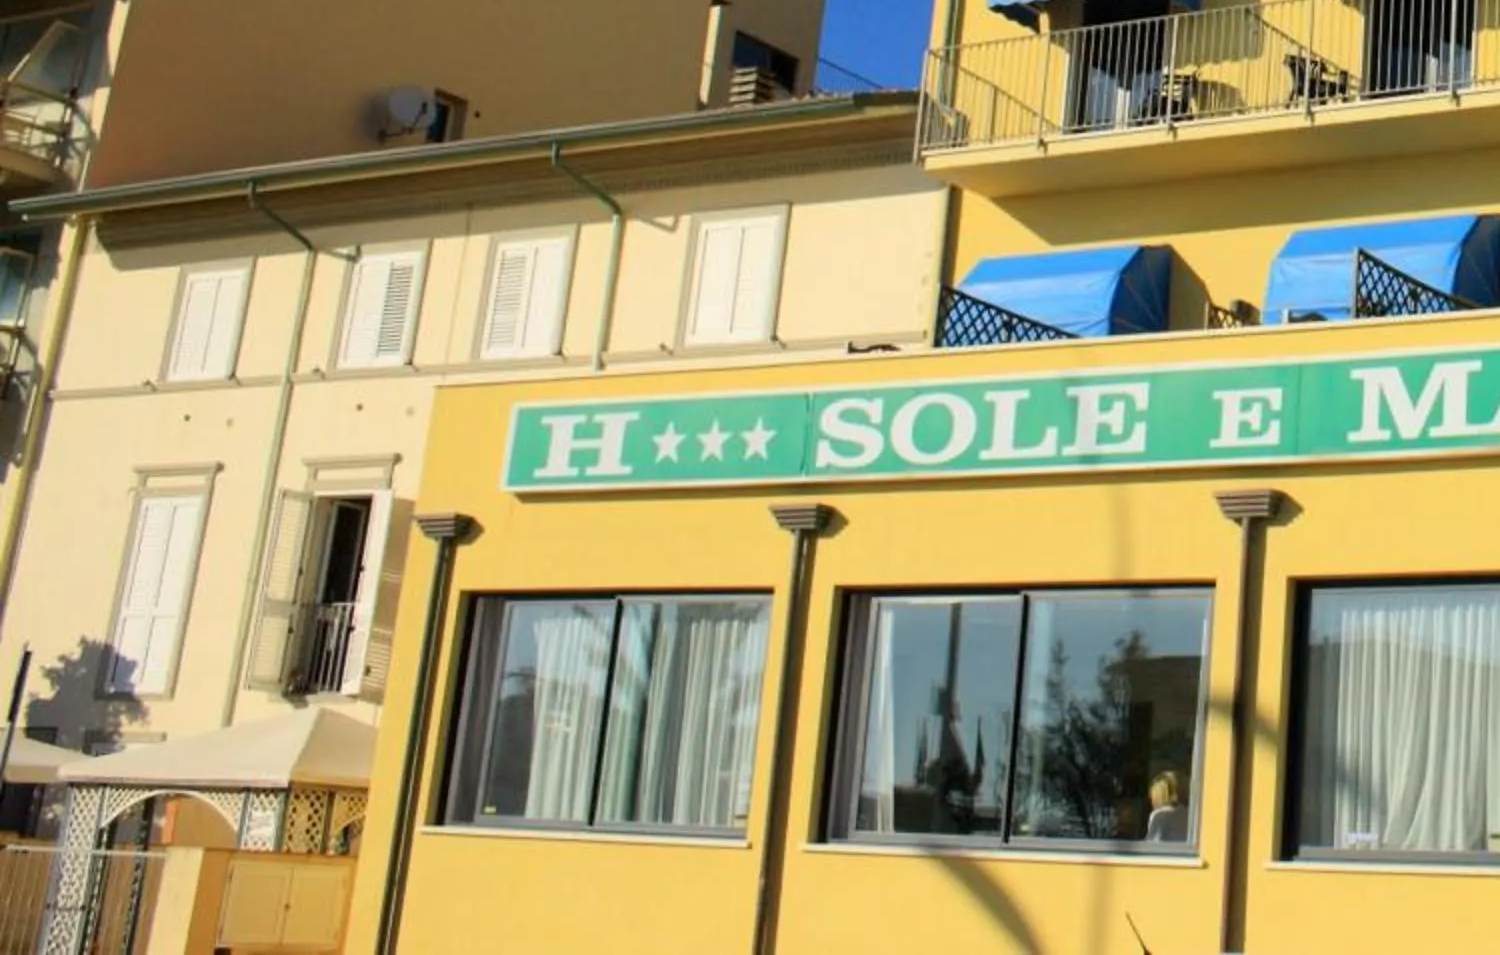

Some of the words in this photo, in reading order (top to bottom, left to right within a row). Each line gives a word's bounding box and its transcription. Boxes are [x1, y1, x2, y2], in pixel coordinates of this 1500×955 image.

[533, 411, 640, 479] H
[815, 382, 1151, 468] SOLE
[1209, 387, 1283, 448] E
